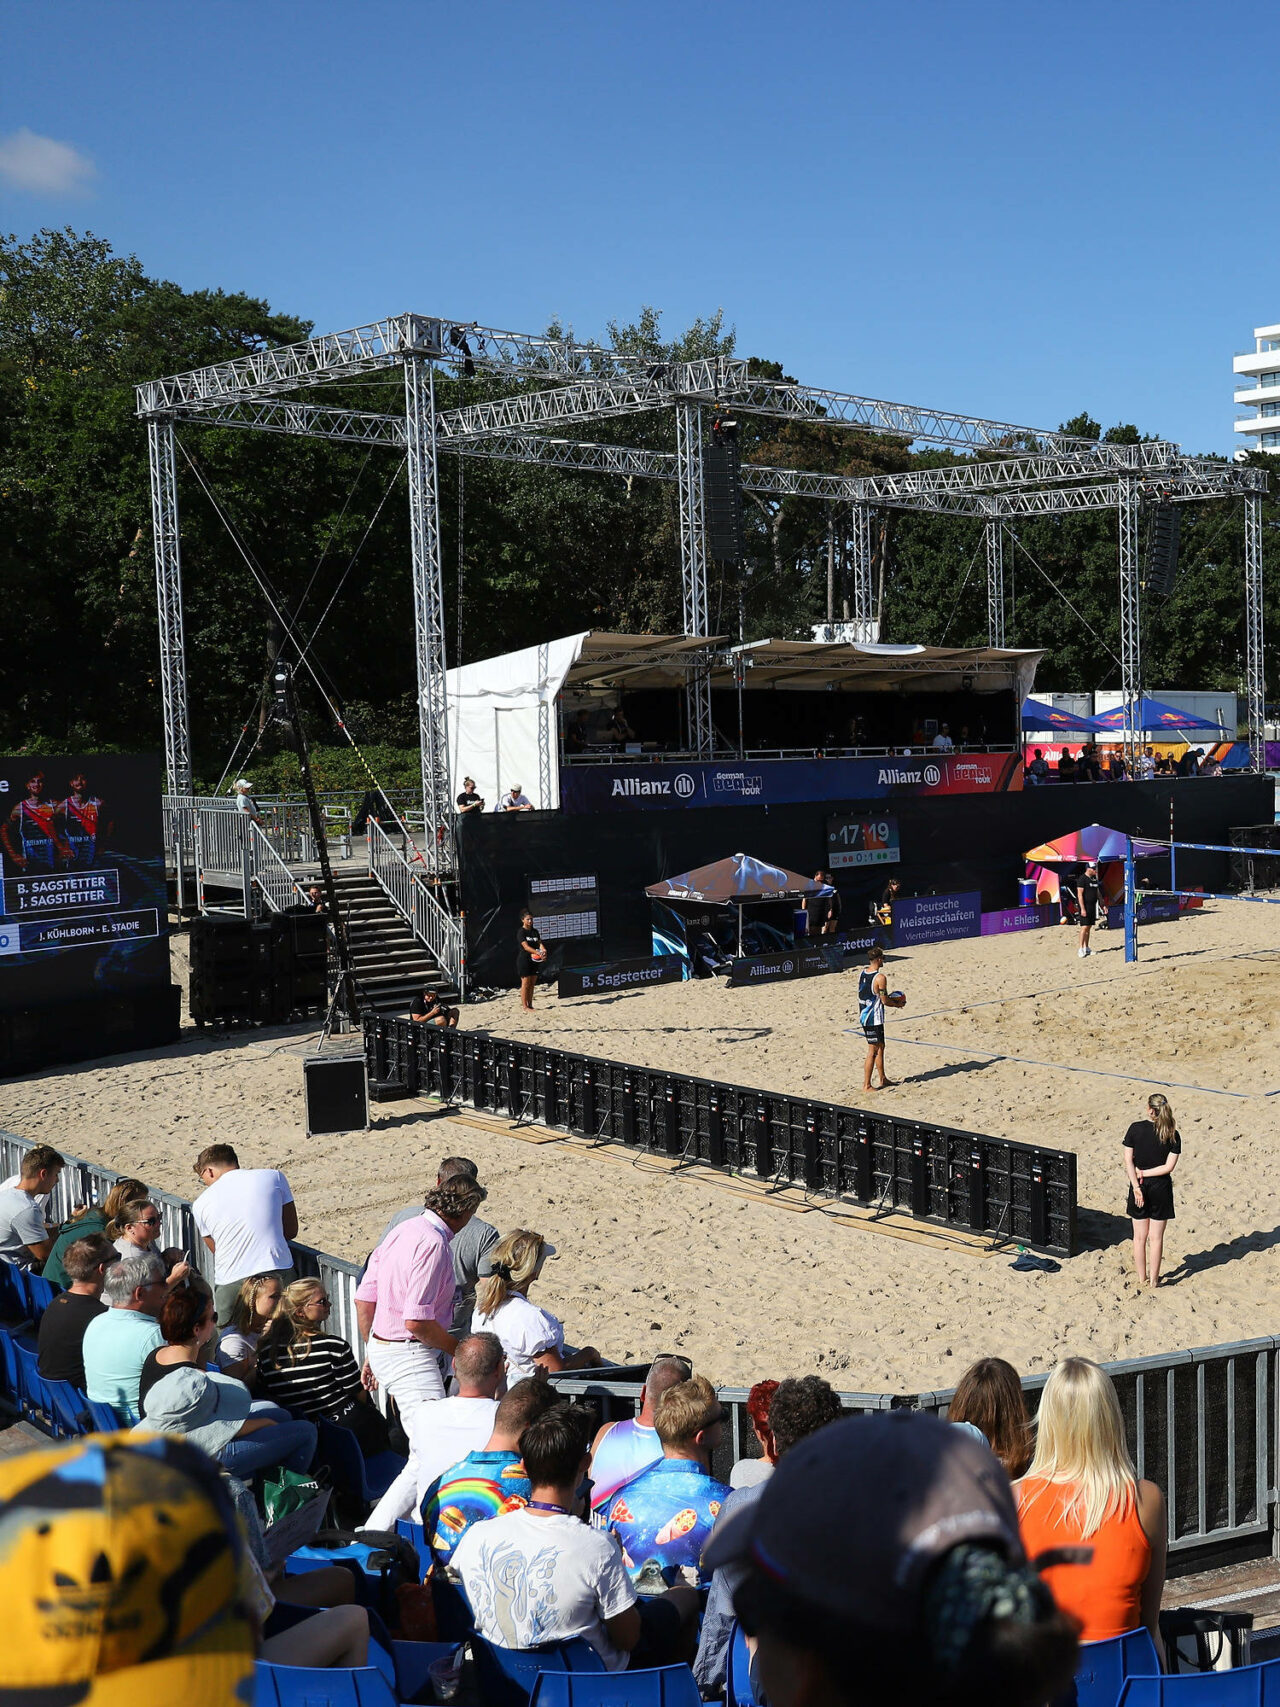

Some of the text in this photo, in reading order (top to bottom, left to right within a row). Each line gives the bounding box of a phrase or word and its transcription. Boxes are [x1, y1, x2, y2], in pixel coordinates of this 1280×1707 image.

[878, 769, 922, 784] Allianz
[612, 779, 671, 796] Allianz
[18, 876, 106, 894] B. SAGSTETTER
[20, 890, 105, 909] J. SAGSTETTER
[916, 899, 959, 913] Deutsche
[900, 910, 975, 928] Meisterschaften
[1003, 914, 1040, 927] N. Ehlers
[39, 932, 46, 941] J.
[47, 926, 95, 940] KÜHLBORN
[102, 924, 110, 933] E.
[112, 921, 139, 932] STADIE
[906, 926, 970, 940] Viertelfinale Winner
[582, 968, 663, 988] B. Sagstetter
[750, 964, 781, 976] Allianz
